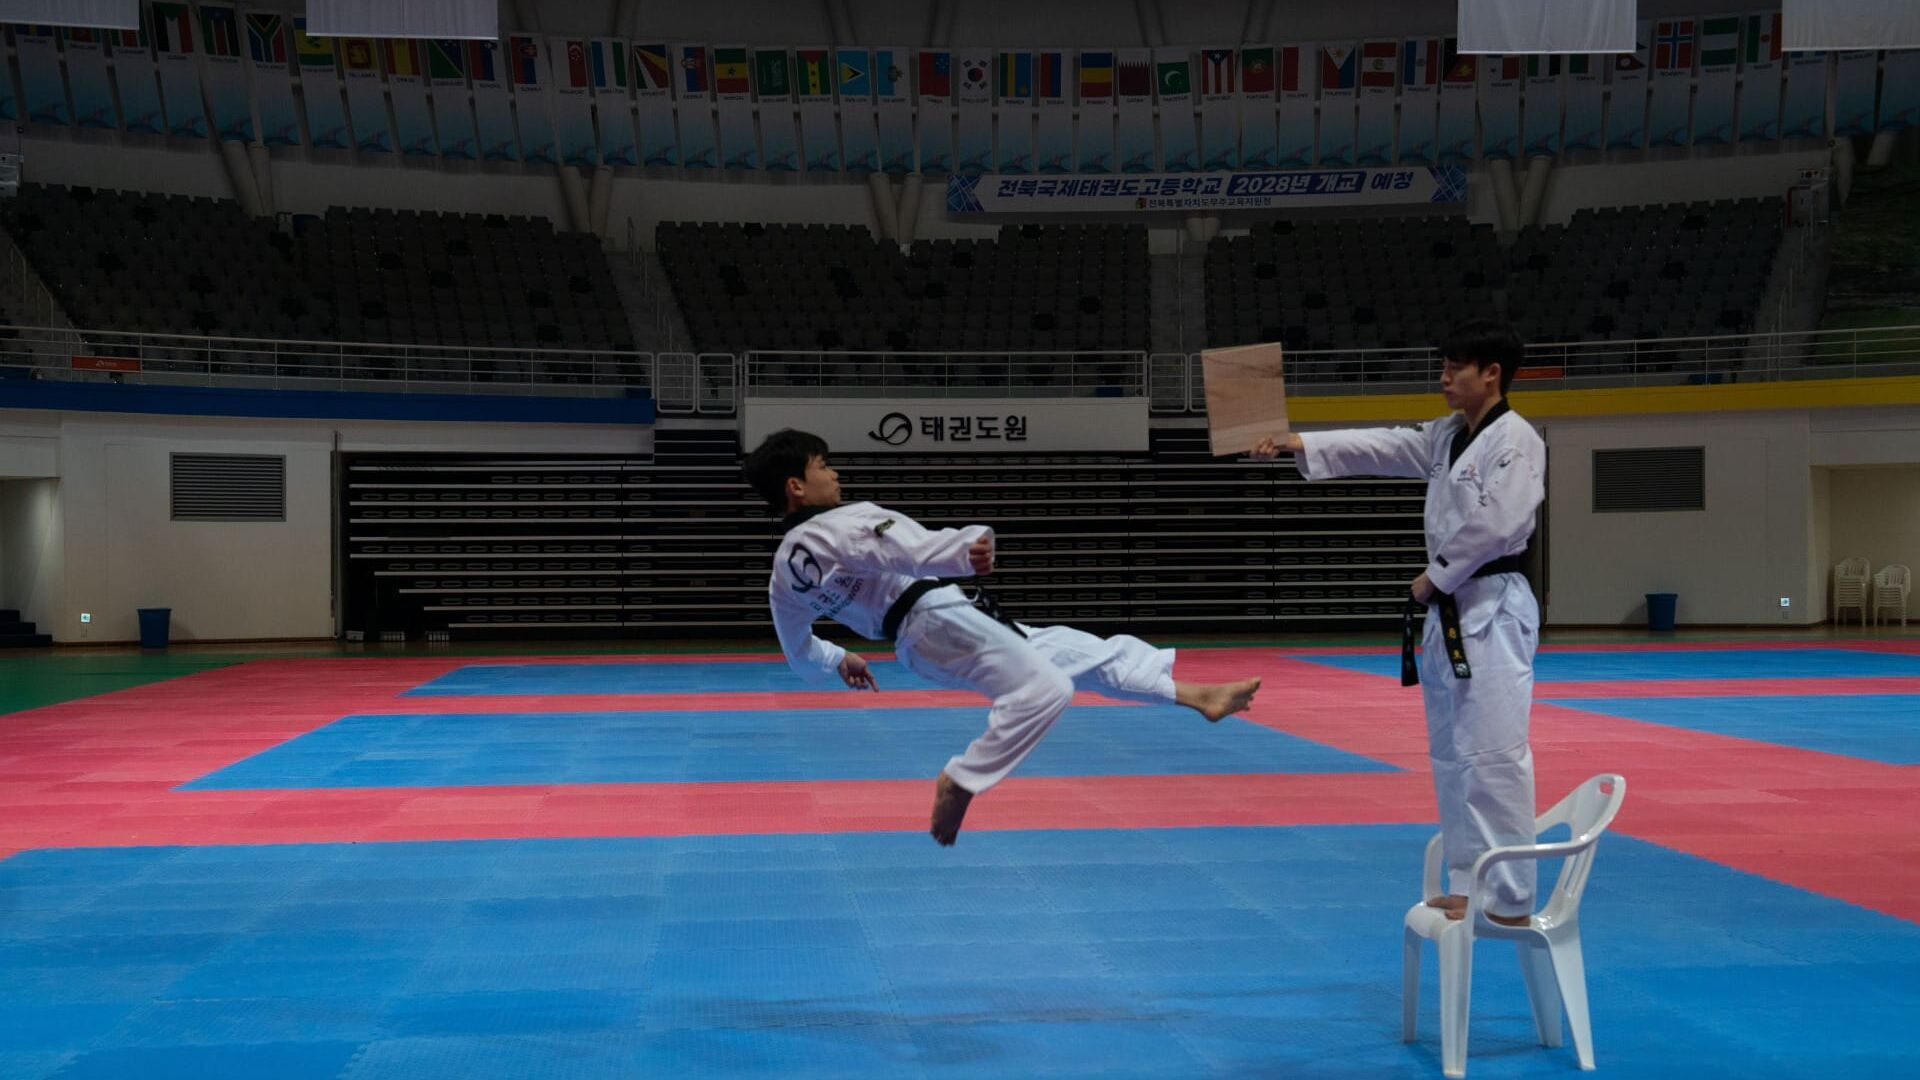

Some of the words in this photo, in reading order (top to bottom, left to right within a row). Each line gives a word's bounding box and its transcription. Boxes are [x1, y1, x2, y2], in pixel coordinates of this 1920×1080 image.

[997, 177, 1223, 197] 전북국제태권도고등학교
[1233, 175, 1310, 194] 2028년
[1315, 173, 1357, 192] 개교
[1371, 172, 1414, 190] 예정
[919, 415, 1027, 441] 태권도원
